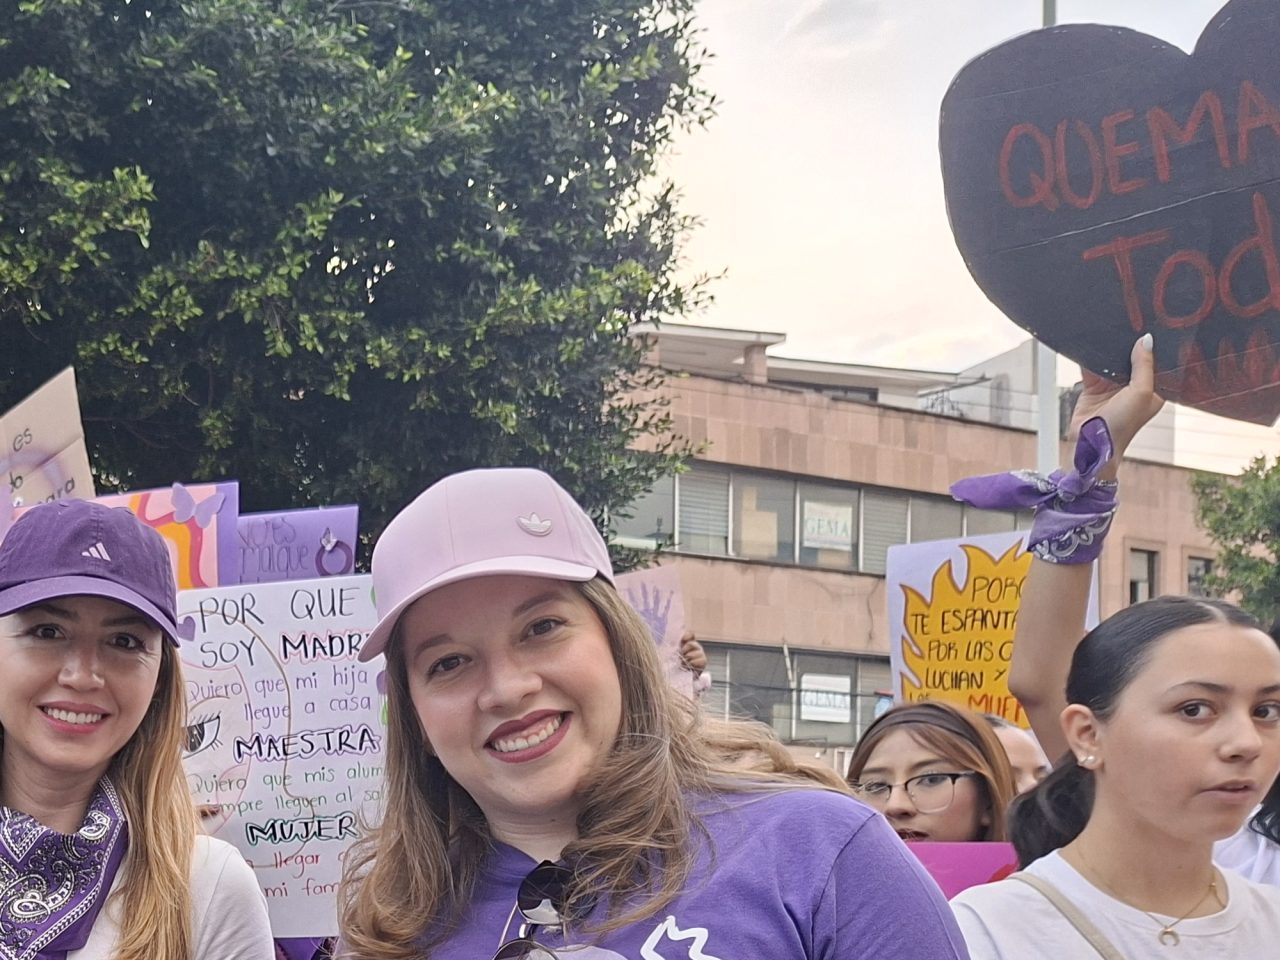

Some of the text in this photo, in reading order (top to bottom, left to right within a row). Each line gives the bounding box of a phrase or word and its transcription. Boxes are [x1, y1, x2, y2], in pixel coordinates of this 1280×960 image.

[12, 427, 33, 452] es
[199, 587, 361, 633] POR QUE
[911, 612, 931, 635] TE
[200, 631, 370, 669] SOY MADR
[927, 640, 958, 662] POR
[965, 640, 994, 662] LAS
[185, 664, 368, 701] Quiero que mi hija
[244, 696, 371, 729] llegue a casa
[234, 726, 380, 762] MAESTRA
[262, 774, 293, 792] que
[304, 766, 336, 783] mis
[274, 794, 328, 817] lleguen
[335, 785, 353, 803] al
[247, 814, 360, 845] MUJER
[273, 851, 321, 879] llegar
[264, 882, 289, 898] mi
